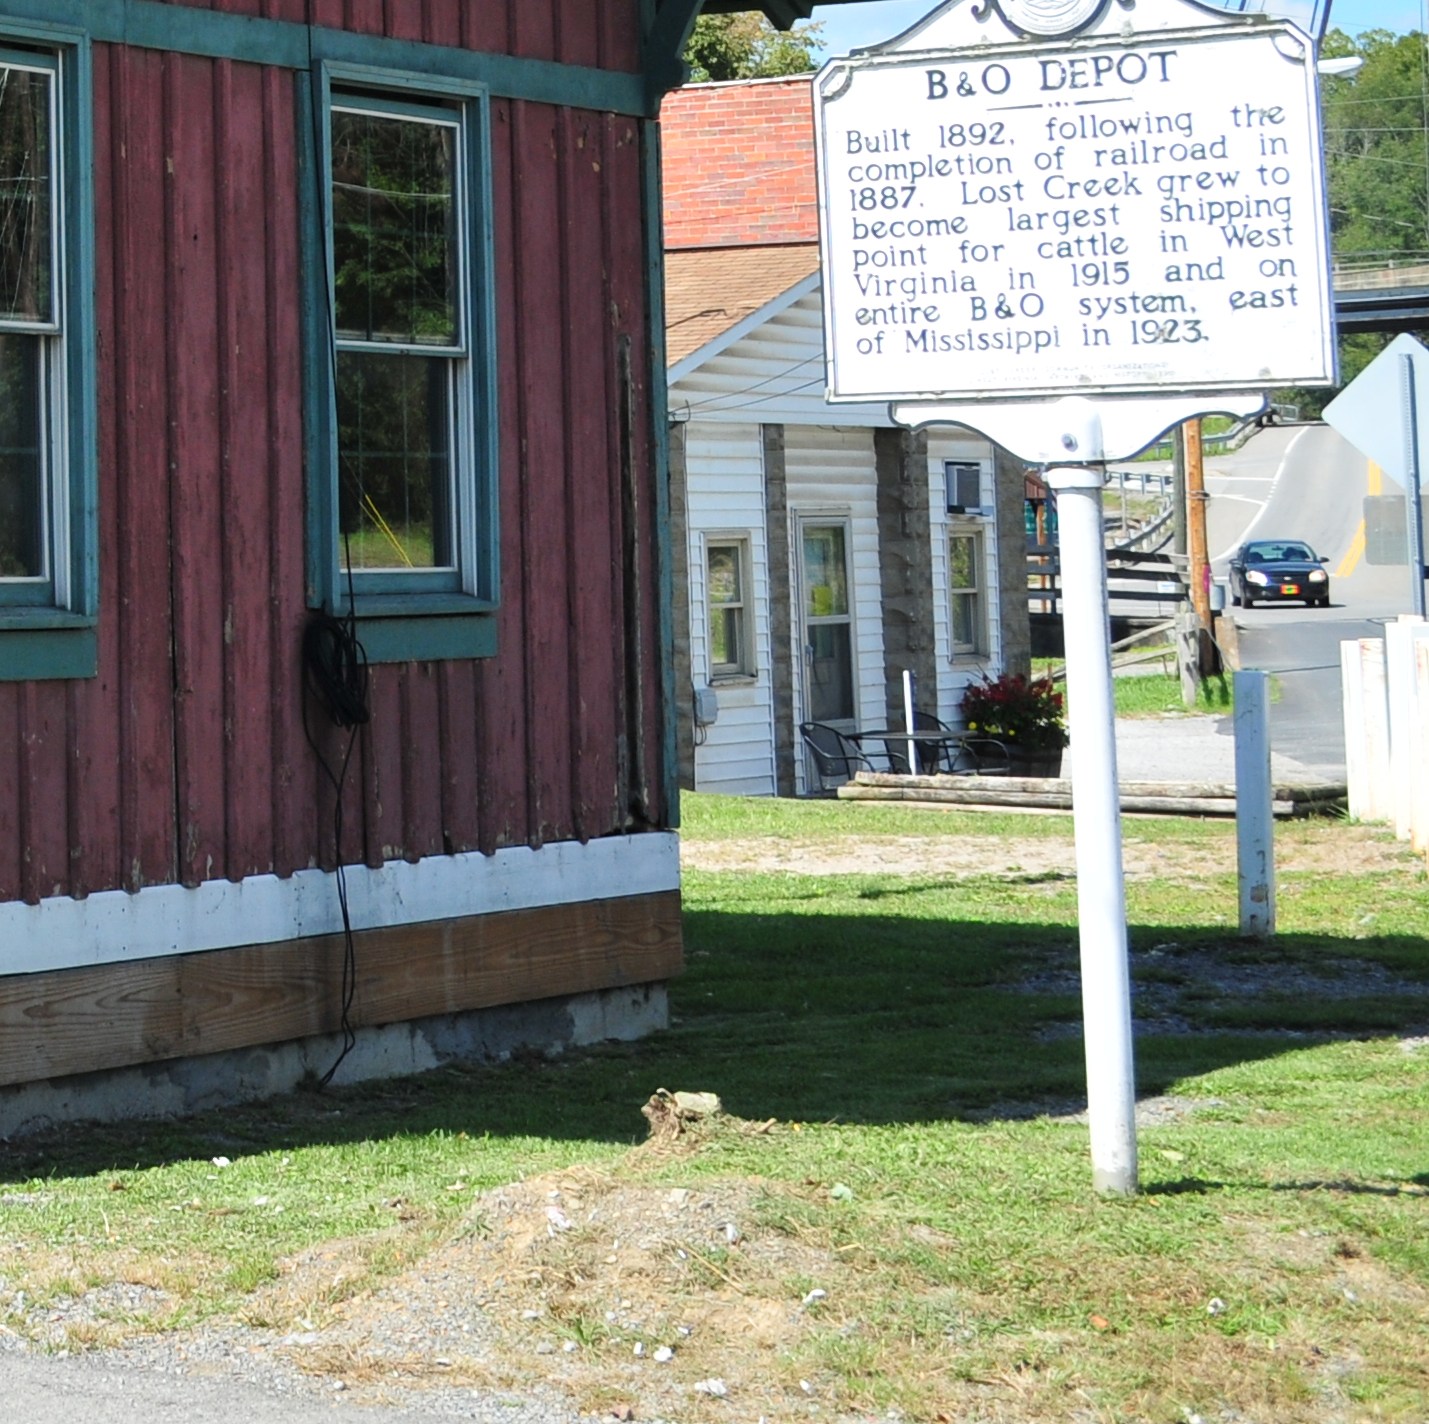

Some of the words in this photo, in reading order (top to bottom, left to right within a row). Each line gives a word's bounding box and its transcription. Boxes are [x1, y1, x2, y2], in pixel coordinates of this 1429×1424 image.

[1038, 50, 1178, 91] DEPOT
[846, 128, 911, 154] Built
[1046, 111, 1193, 141] following
[1230, 103, 1286, 128] the
[848, 153, 1013, 184] completion
[1034, 145, 1065, 170] of
[1094, 135, 1228, 167] railroad
[1259, 133, 1288, 156] in
[961, 179, 1024, 205] Lost
[1043, 171, 1142, 200] Creek
[1157, 170, 1240, 201] grew
[1256, 164, 1290, 186] to
[852, 216, 968, 240] become
[1007, 203, 1120, 235] largest
[1160, 195, 1291, 225] shipping
[852, 244, 927, 272] point
[958, 239, 1005, 263] for
[1037, 232, 1129, 259] cattle
[1159, 230, 1188, 252] in
[1219, 223, 1293, 249] West
[853, 270, 977, 303] Virginia
[1008, 267, 1036, 290] in
[1071, 260, 1130, 287] 1915
[1164, 256, 1225, 282] and
[1259, 258, 1298, 277] on
[855, 301, 940, 326] entire
[1078, 291, 1196, 321] system,
[1229, 283, 1298, 310] east
[856, 330, 885, 355] of
[905, 325, 1061, 354] Mississippi
[1082, 323, 1111, 346] in
[1130, 319, 1209, 345] 1923.
